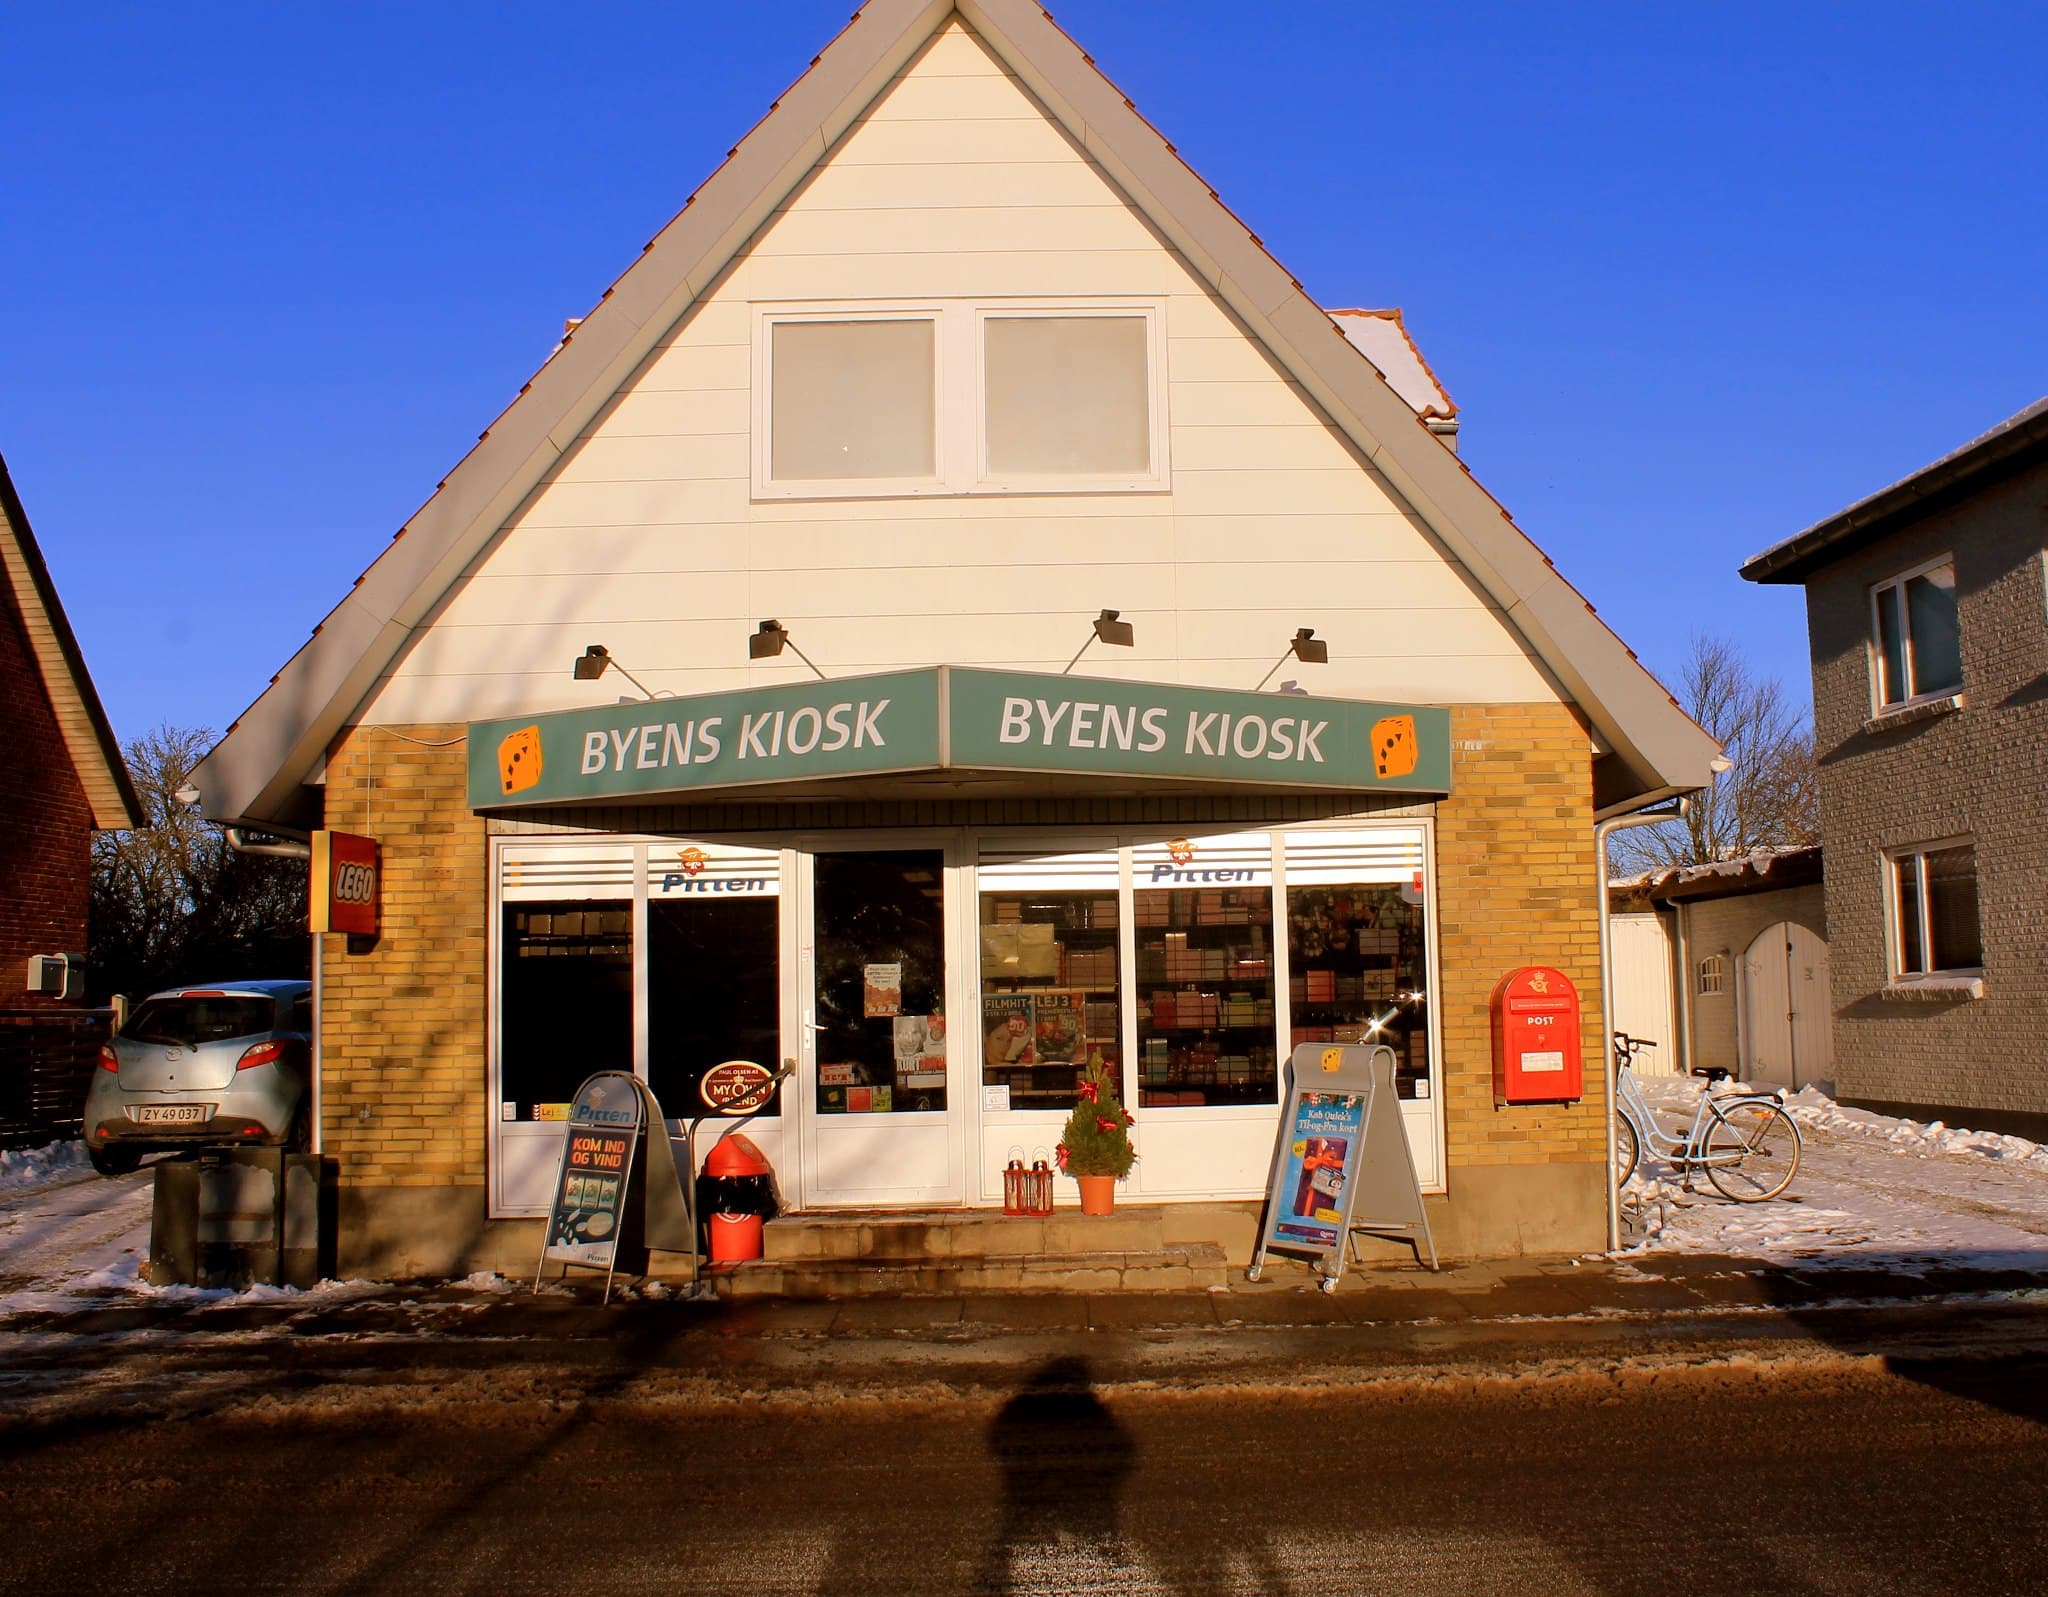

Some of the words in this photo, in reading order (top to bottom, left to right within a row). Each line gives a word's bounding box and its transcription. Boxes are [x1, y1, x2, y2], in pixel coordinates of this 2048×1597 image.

[581, 717, 723, 775] BYENS
[738, 699, 892, 760] KIOSK
[999, 697, 1168, 752] BYENS
[1185, 711, 1329, 763] KIOSK
[1151, 864, 1256, 883] Pitten
[336, 865, 374, 902] LEGO
[662, 873, 767, 893] Pitten
[984, 999, 1027, 1009] FILMHIT
[1037, 996, 1058, 1007] LEJ
[1062, 996, 1069, 1007] 3
[1527, 1016, 1554, 1025] POST
[713, 1085, 731, 1096] MY
[722, 1096, 758, 1106] BND
[144, 1109, 159, 1120] ZY
[162, 1109, 176, 1120] 49
[178, 1108, 199, 1120] 037
[576, 1104, 630, 1122] Pitten
[1324, 1110, 1352, 1121] Quick's
[1339, 1122, 1358, 1133] kort
[573, 1137, 602, 1152] KOM
[604, 1139, 626, 1153] IND
[572, 1151, 590, 1165] OG
[593, 1153, 622, 1168] VIND
